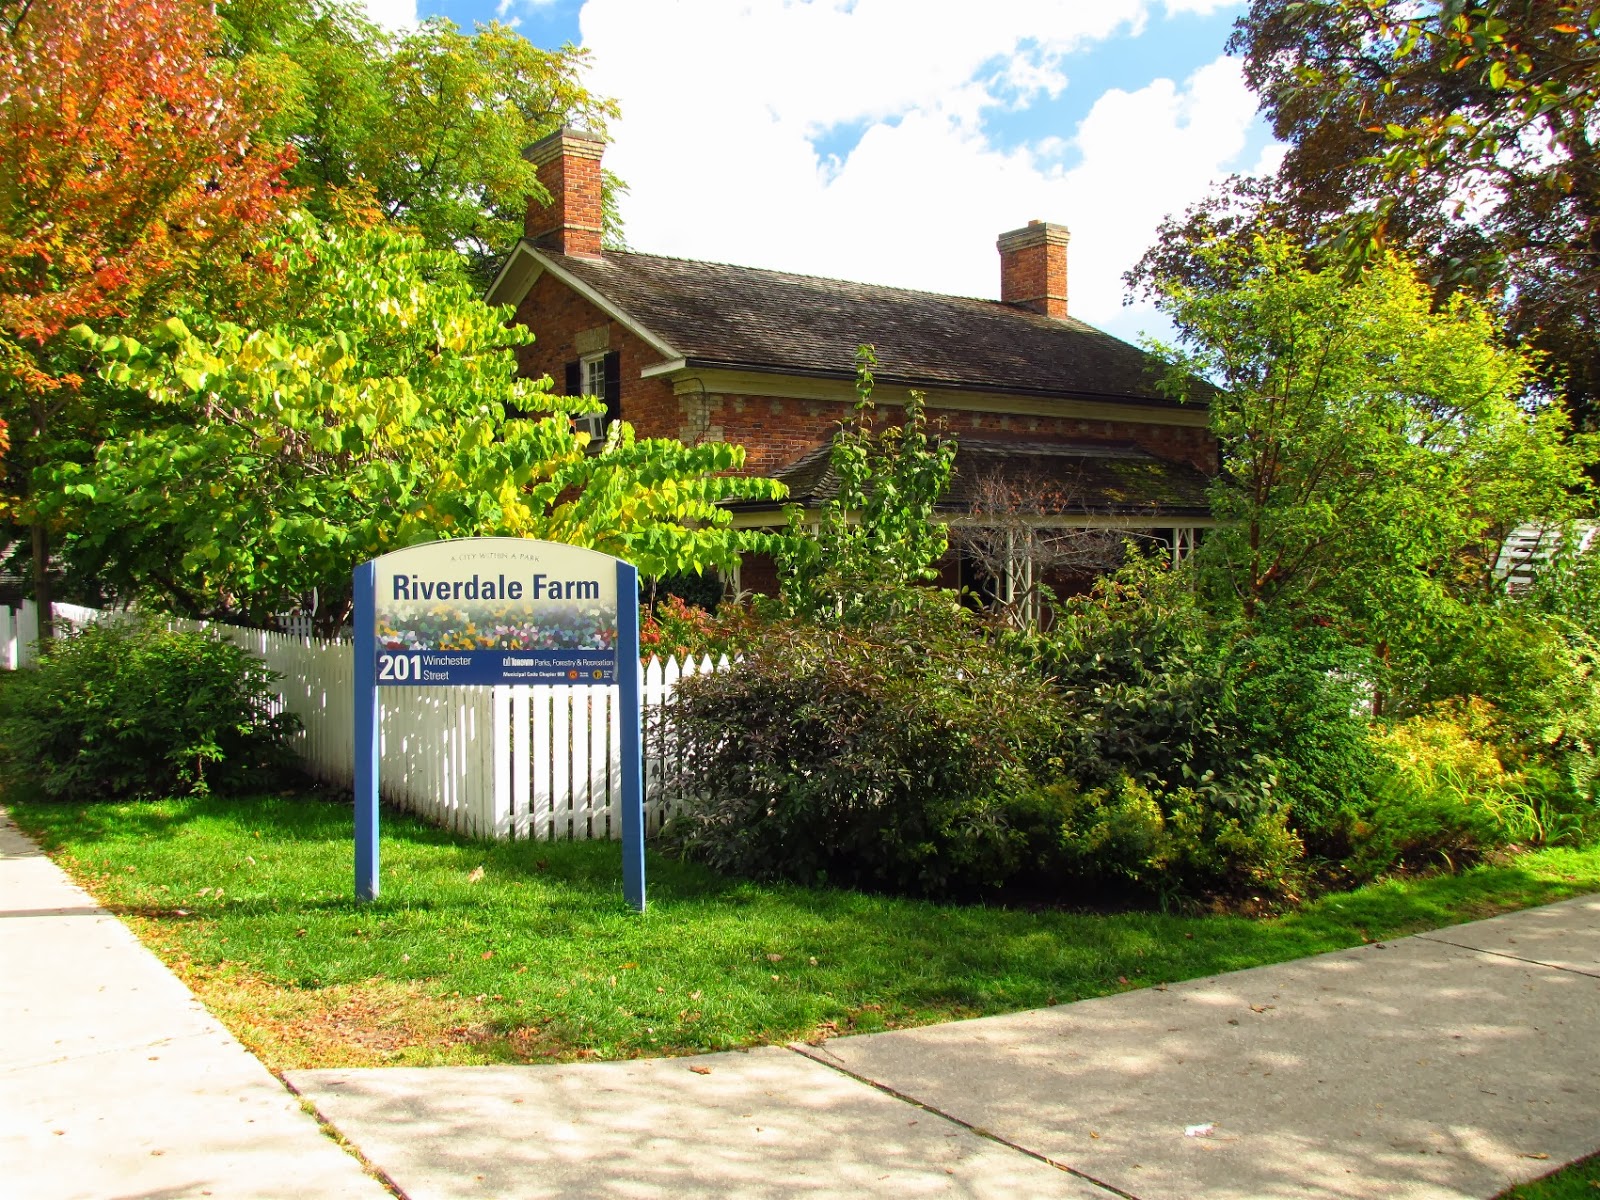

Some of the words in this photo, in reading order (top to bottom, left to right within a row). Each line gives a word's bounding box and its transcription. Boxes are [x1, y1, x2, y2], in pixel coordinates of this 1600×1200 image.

[520, 553, 540, 562] PARK
[393, 574, 522, 600] Riverdale
[533, 573, 599, 599] Farm
[423, 655, 472, 666] Winchester
[534, 658, 552, 668] Parks,
[553, 658, 577, 667] Forestry
[583, 658, 614, 666] Recreation
[379, 654, 421, 680] 201
[423, 669, 449, 681] Street
